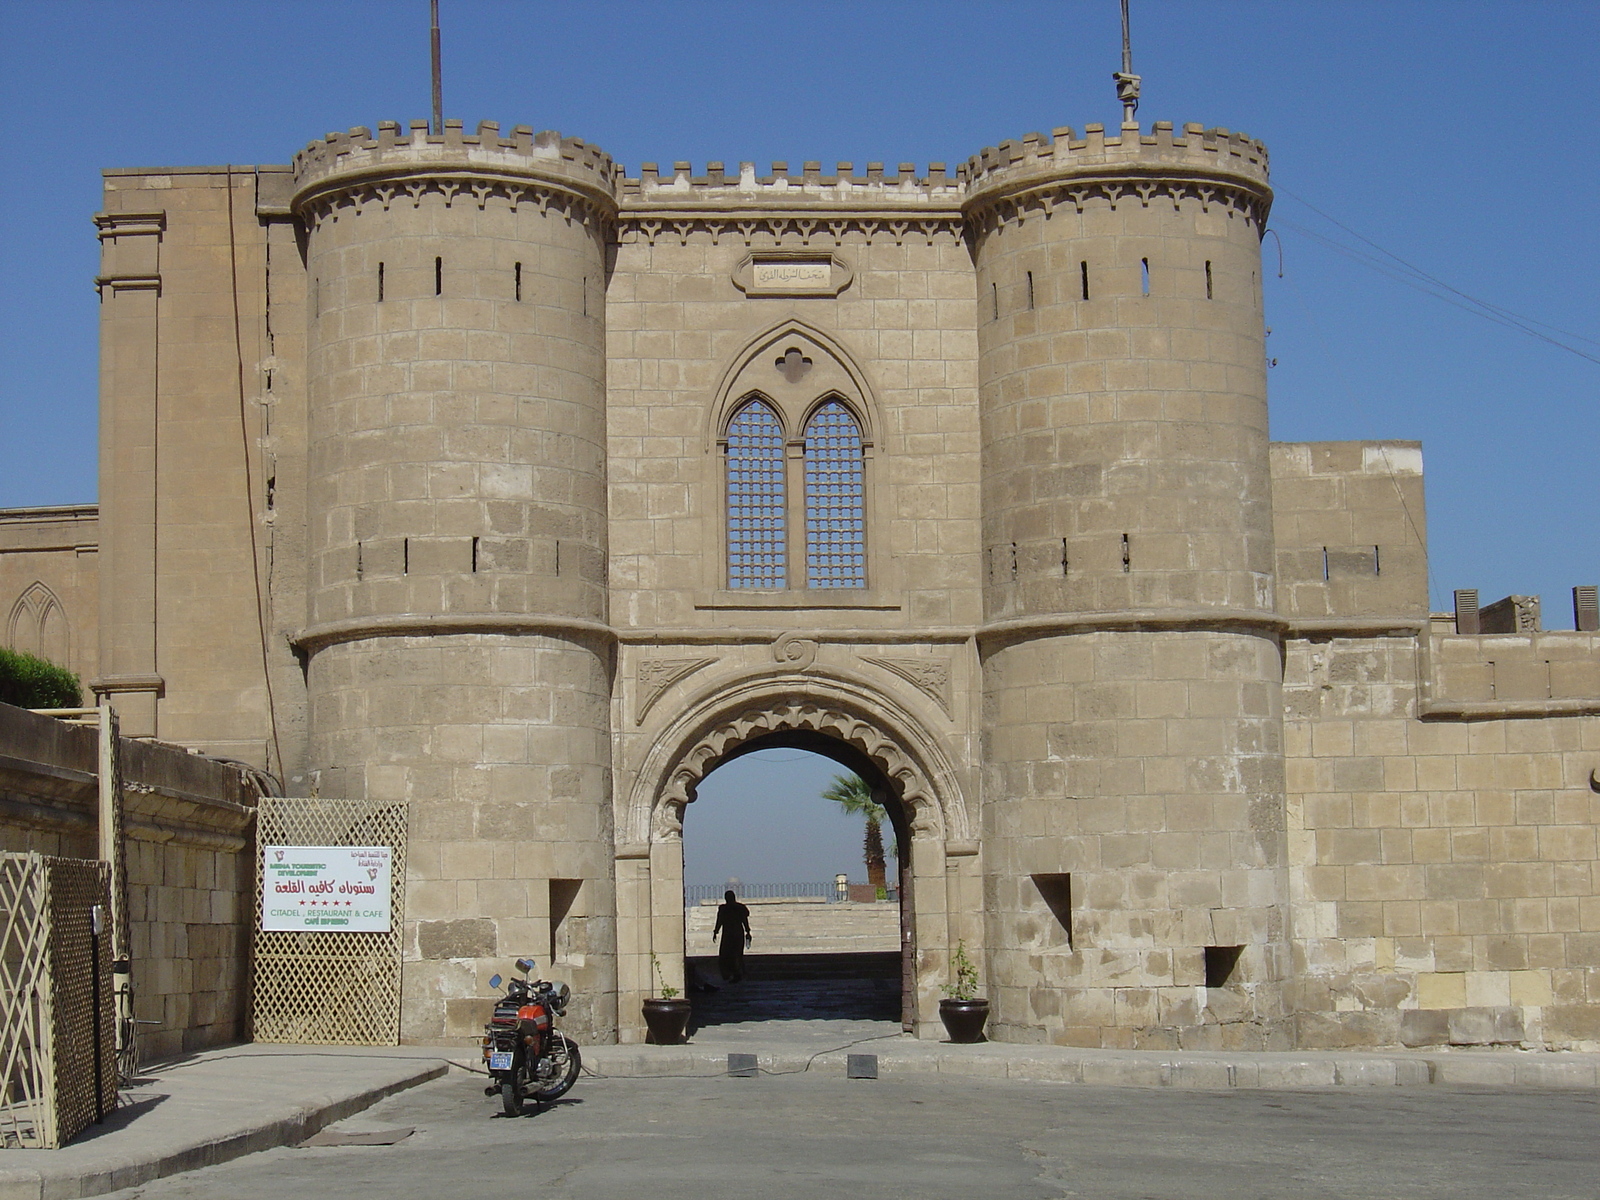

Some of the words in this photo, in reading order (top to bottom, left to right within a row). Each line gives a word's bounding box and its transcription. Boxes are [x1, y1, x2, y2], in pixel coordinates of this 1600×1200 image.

[800, 270, 825, 282] متحف
[275, 879, 306, 894] القلعة
[308, 879, 336, 897] كافيه
[270, 909, 301, 917] CITADEL
[307, 909, 353, 917] RESTAURANT
[362, 910, 383, 918] CAFE
